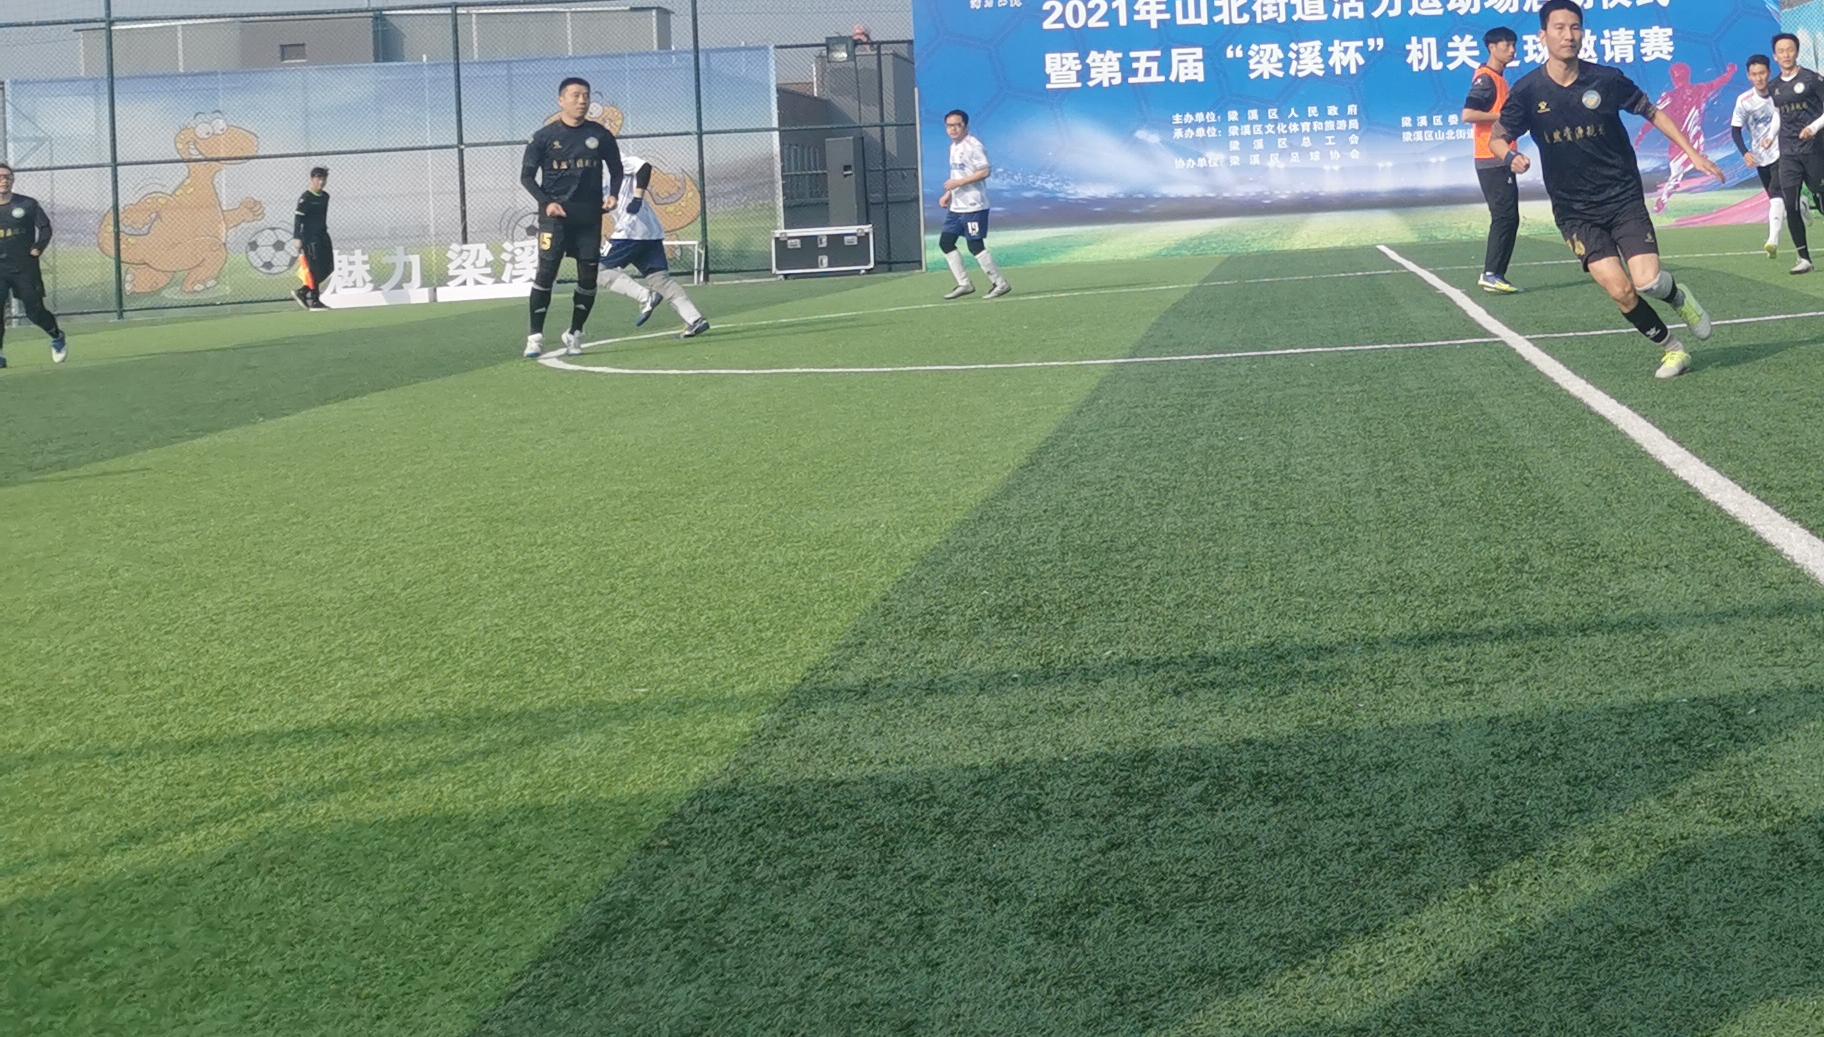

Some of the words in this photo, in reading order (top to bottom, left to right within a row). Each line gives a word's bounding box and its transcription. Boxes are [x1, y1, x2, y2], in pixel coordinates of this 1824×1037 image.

[1045, 26, 1675, 89] 暨第五届“梁溪杯”机关球邀请赛
[967, 221, 980, 236] 19
[322, 246, 422, 294] 魅力
[446, 239, 539, 287] 梁溪
